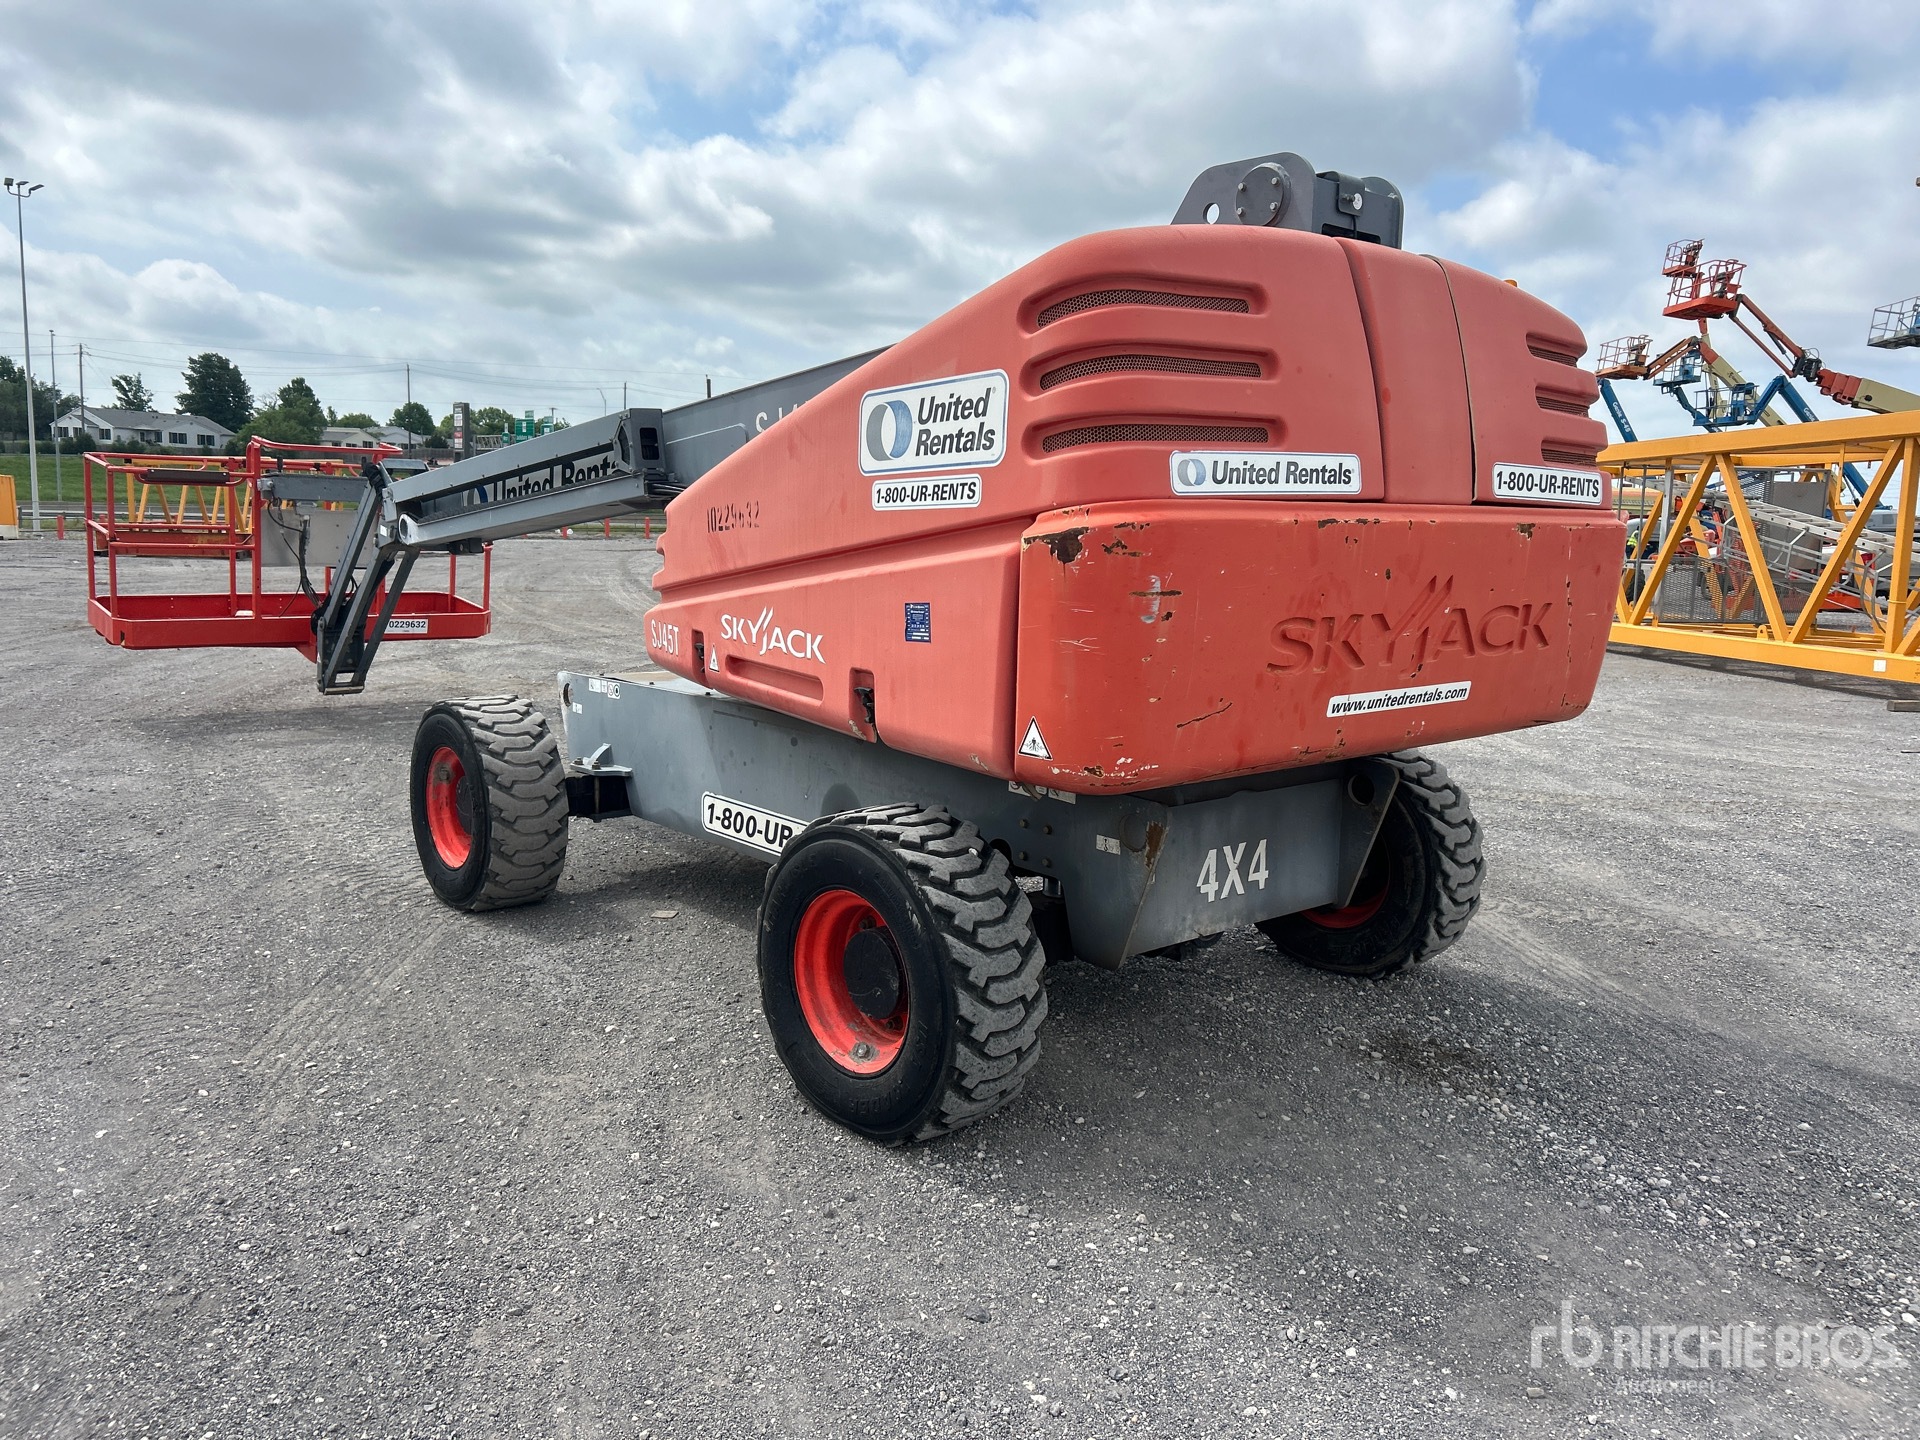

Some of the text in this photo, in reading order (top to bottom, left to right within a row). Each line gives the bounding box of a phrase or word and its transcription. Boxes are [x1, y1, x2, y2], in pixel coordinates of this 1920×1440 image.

[917, 387, 992, 426] United
[915, 421, 997, 457] Rentals
[1211, 460, 1353, 485] United Rentals
[1496, 470, 1600, 498] 1-800-UR-RENTS
[875, 481, 977, 504] 1-800-UR-RENTS
[651, 619, 679, 656] SJ45T
[720, 606, 826, 664] SKYJACK
[1265, 574, 1553, 681] SKYJACK
[1331, 686, 1468, 715] www.unitedrentals.com
[1196, 838, 1270, 903] 4X4
